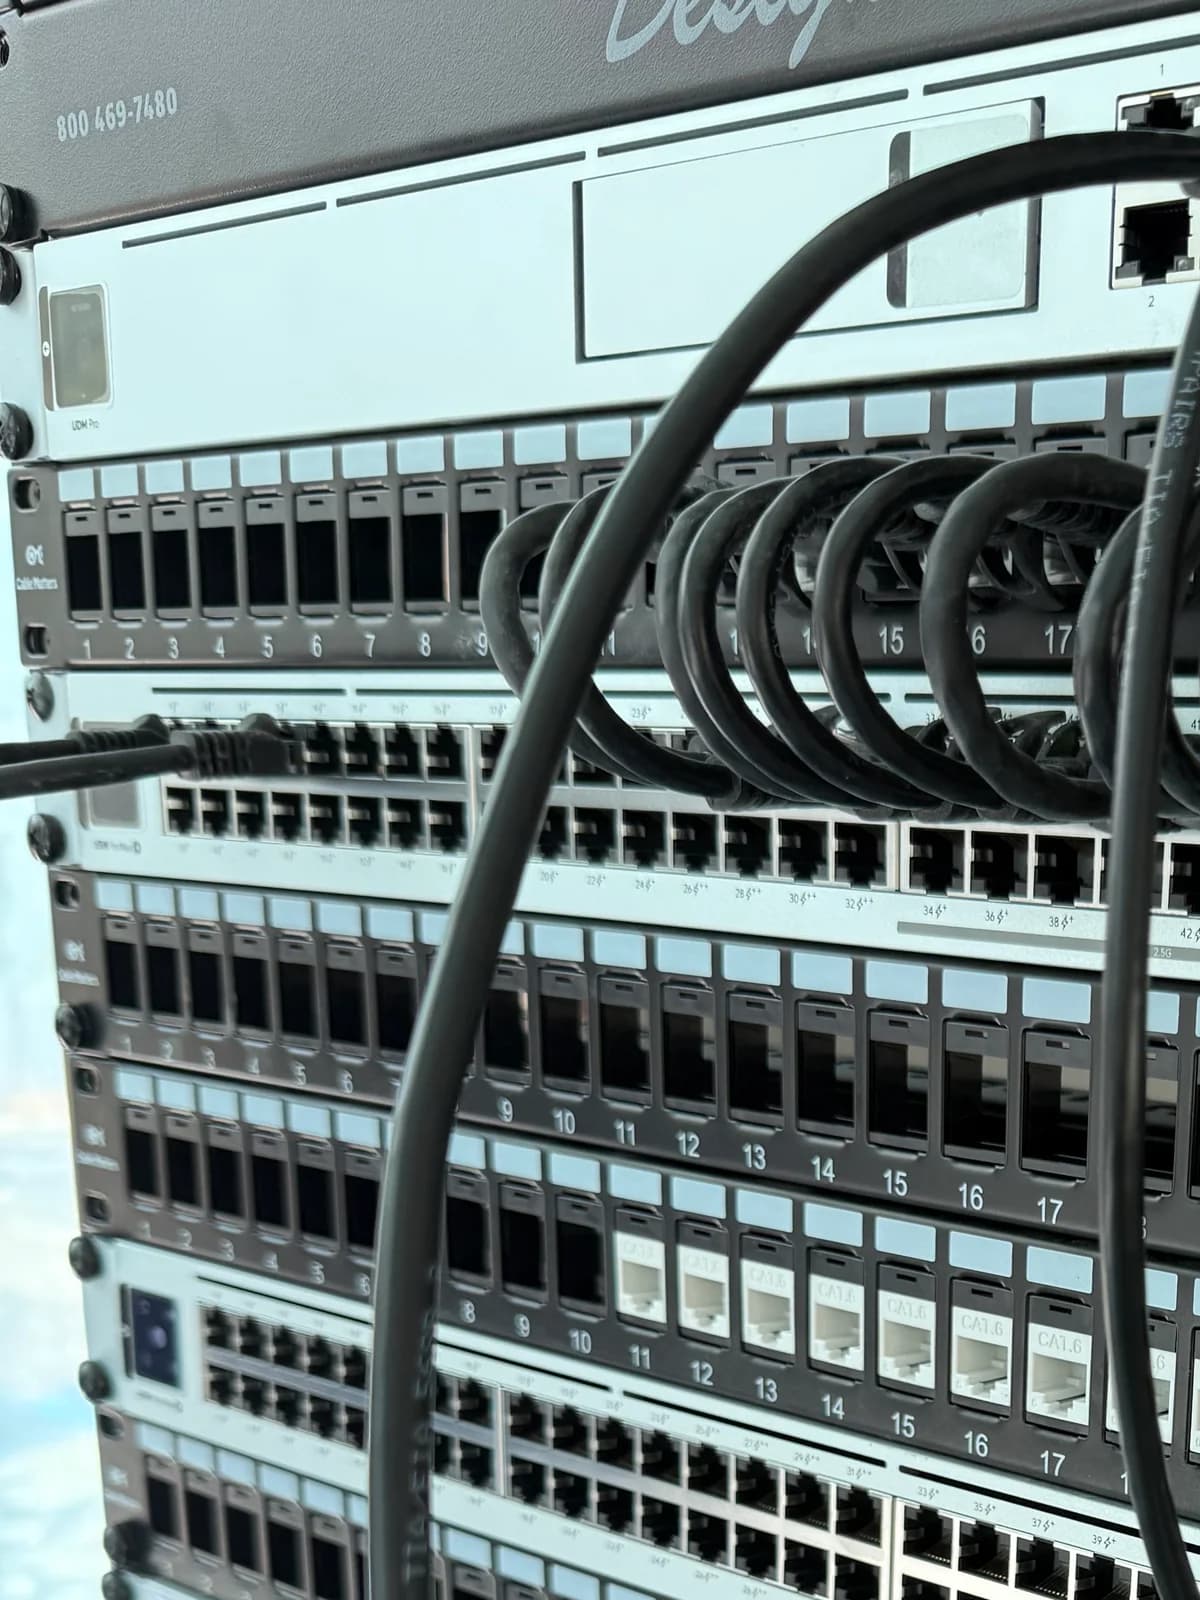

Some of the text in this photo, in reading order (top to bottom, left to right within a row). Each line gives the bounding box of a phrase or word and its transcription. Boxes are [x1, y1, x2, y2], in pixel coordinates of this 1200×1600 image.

[56, 87, 178, 142] 800 469-7480
[83, 639, 92, 660] 1
[123, 636, 136, 660] 2
[167, 636, 180, 660] 3
[213, 635, 226, 658] 4
[261, 634, 275, 659] 5
[310, 631, 323, 658] 6
[363, 633, 377, 658] 7
[419, 632, 432, 657] 8
[475, 632, 488, 657] 9
[879, 625, 905, 655] 15
[1044, 624, 1074, 655] 17
[497, 1097, 514, 1122] 9
[552, 1107, 577, 1136] 10
[614, 1118, 636, 1147] 11
[677, 1130, 701, 1159] 12
[741, 1143, 767, 1171] 13
[809, 1155, 837, 1184] 14
[882, 1168, 909, 1197] 15
[957, 1182, 985, 1211] 16
[1036, 1196, 1064, 1225] 17
[461, 1301, 477, 1325] 8
[513, 1313, 531, 1338] 9
[567, 1328, 593, 1355] 10
[628, 1344, 651, 1371] 11
[690, 1360, 714, 1387] 12
[754, 1376, 778, 1403] 13
[821, 1393, 845, 1421] 14
[889, 1411, 917, 1439] 15
[963, 1429, 990, 1458] 16
[1039, 1449, 1066, 1477] 17
